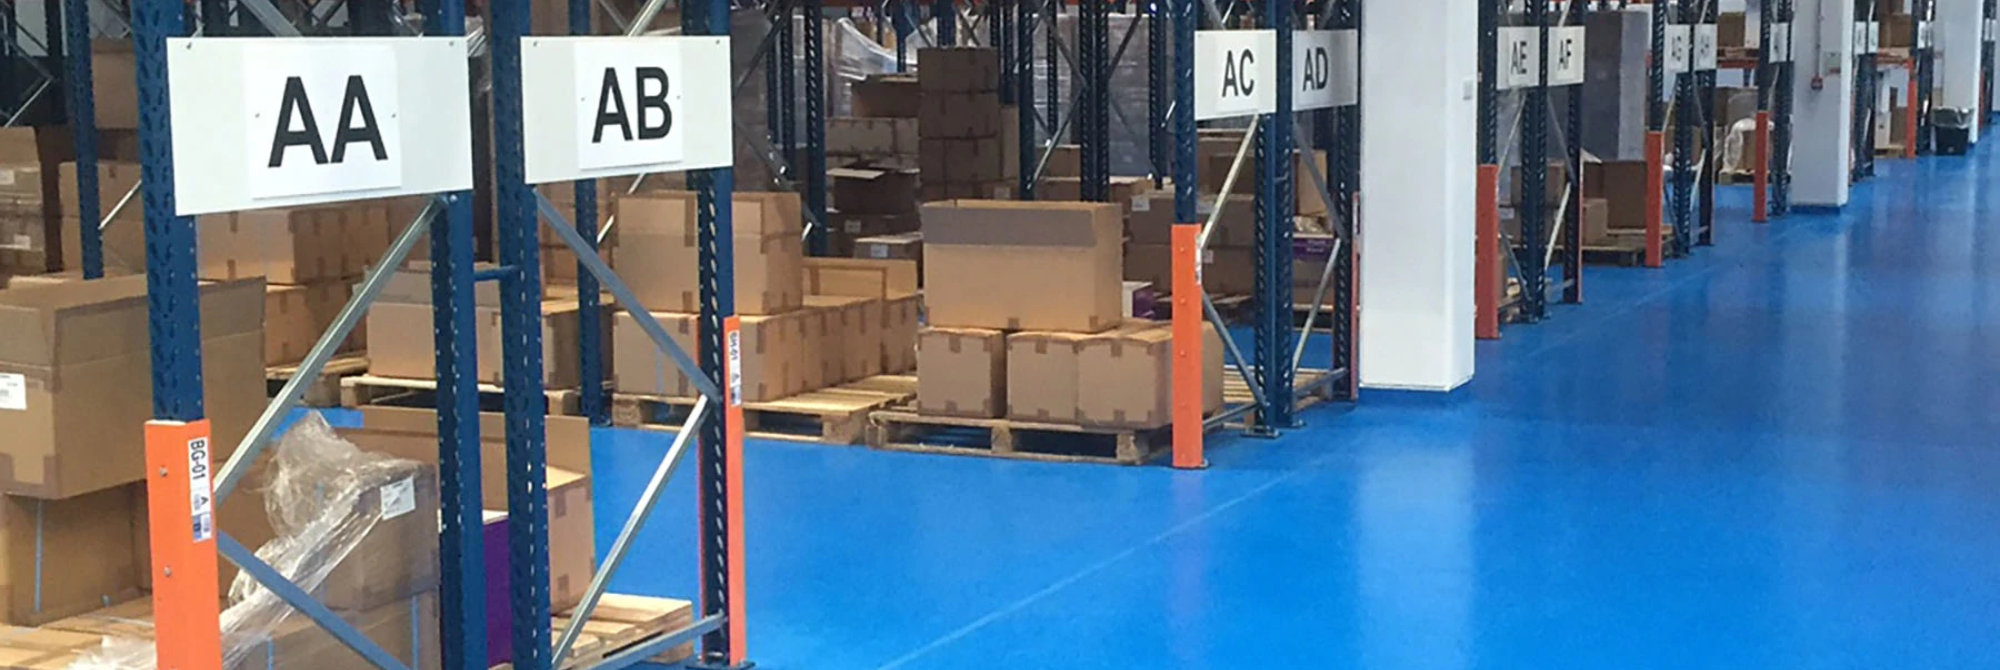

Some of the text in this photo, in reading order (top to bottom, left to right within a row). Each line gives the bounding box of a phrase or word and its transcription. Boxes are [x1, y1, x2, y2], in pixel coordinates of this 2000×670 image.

[1221, 48, 1255, 98] AC
[1302, 46, 1329, 92] AD
[1510, 40, 1527, 75] AE
[1557, 38, 1572, 72] AF
[267, 74, 388, 169] AA
[591, 65, 674, 144] AB
[190, 439, 206, 480] BG-01
